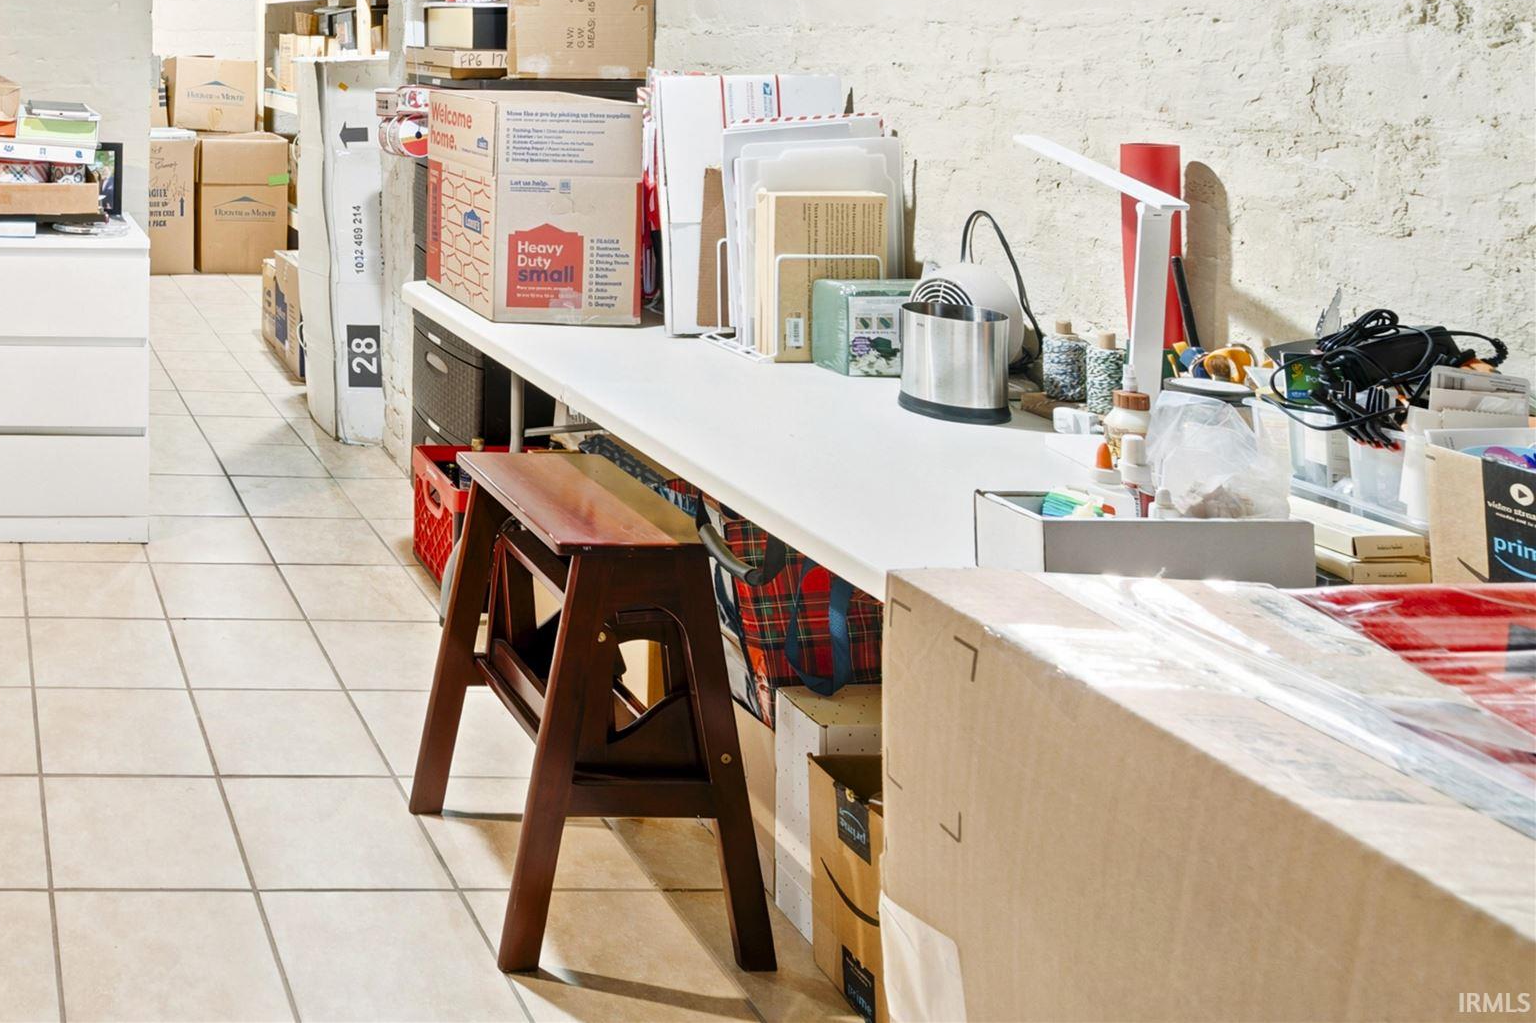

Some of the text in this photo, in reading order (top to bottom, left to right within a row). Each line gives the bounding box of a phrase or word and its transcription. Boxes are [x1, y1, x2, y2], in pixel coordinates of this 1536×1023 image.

[492, 53, 508, 67] 17
[431, 102, 472, 129] Welcome
[430, 124, 457, 151] home.
[352, 205, 362, 225] 214
[517, 240, 564, 257] Heavy
[517, 255, 552, 270] Duty
[518, 266, 575, 283] small
[350, 337, 378, 374] 28
[839, 819, 866, 845] prime
